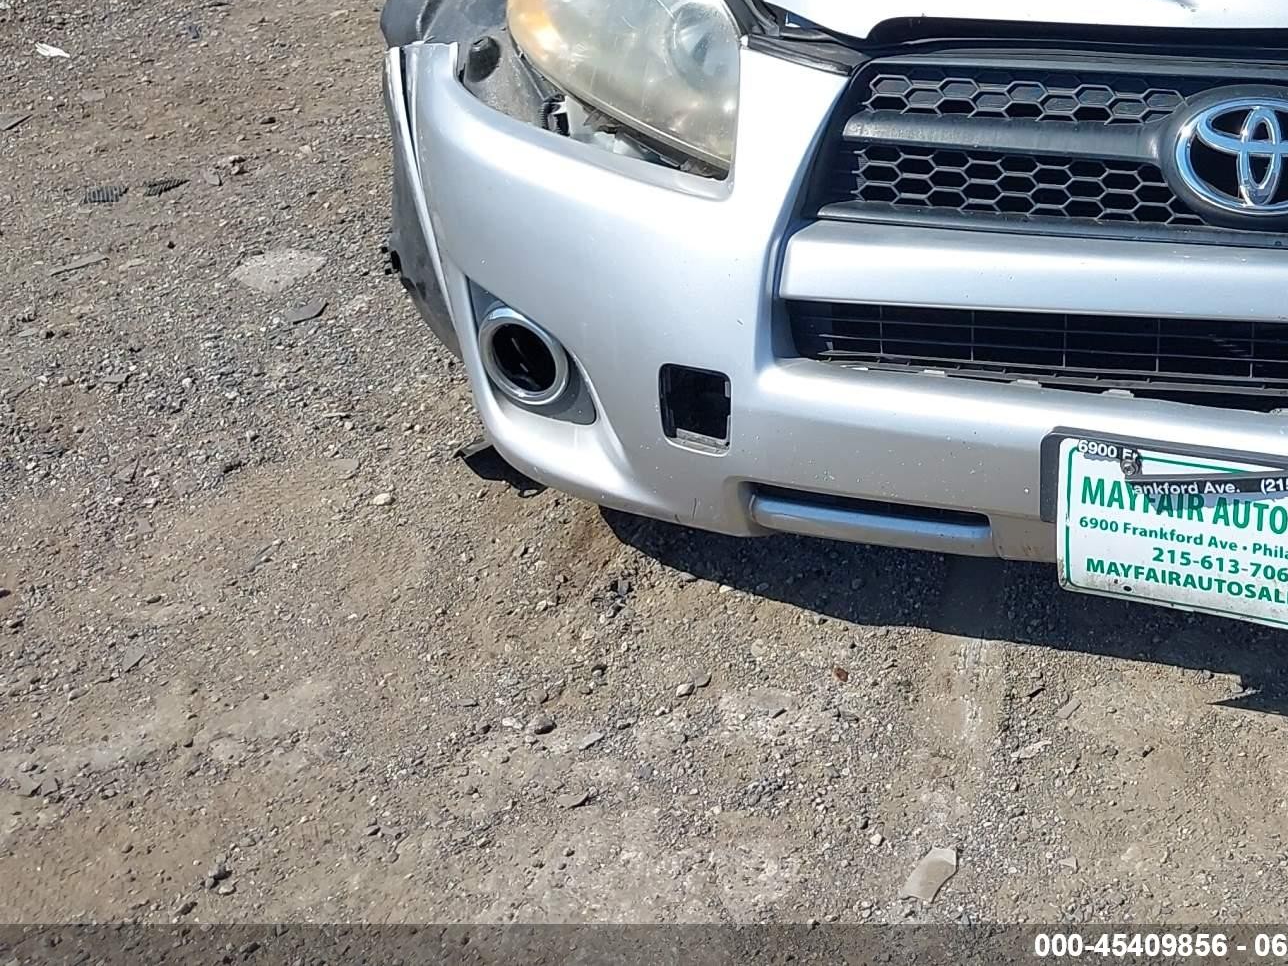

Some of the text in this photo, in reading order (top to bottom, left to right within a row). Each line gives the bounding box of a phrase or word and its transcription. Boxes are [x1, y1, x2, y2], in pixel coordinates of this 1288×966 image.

[1078, 440, 1118, 458] 6900
[1204, 483, 1240, 494] Ave.
[1081, 476, 1204, 522] MAYFAIR
[1212, 496, 1288, 534] AUTO
[1079, 517, 1118, 532] 6900
[1123, 522, 1203, 545] Frankford
[1208, 536, 1238, 551] Ave
